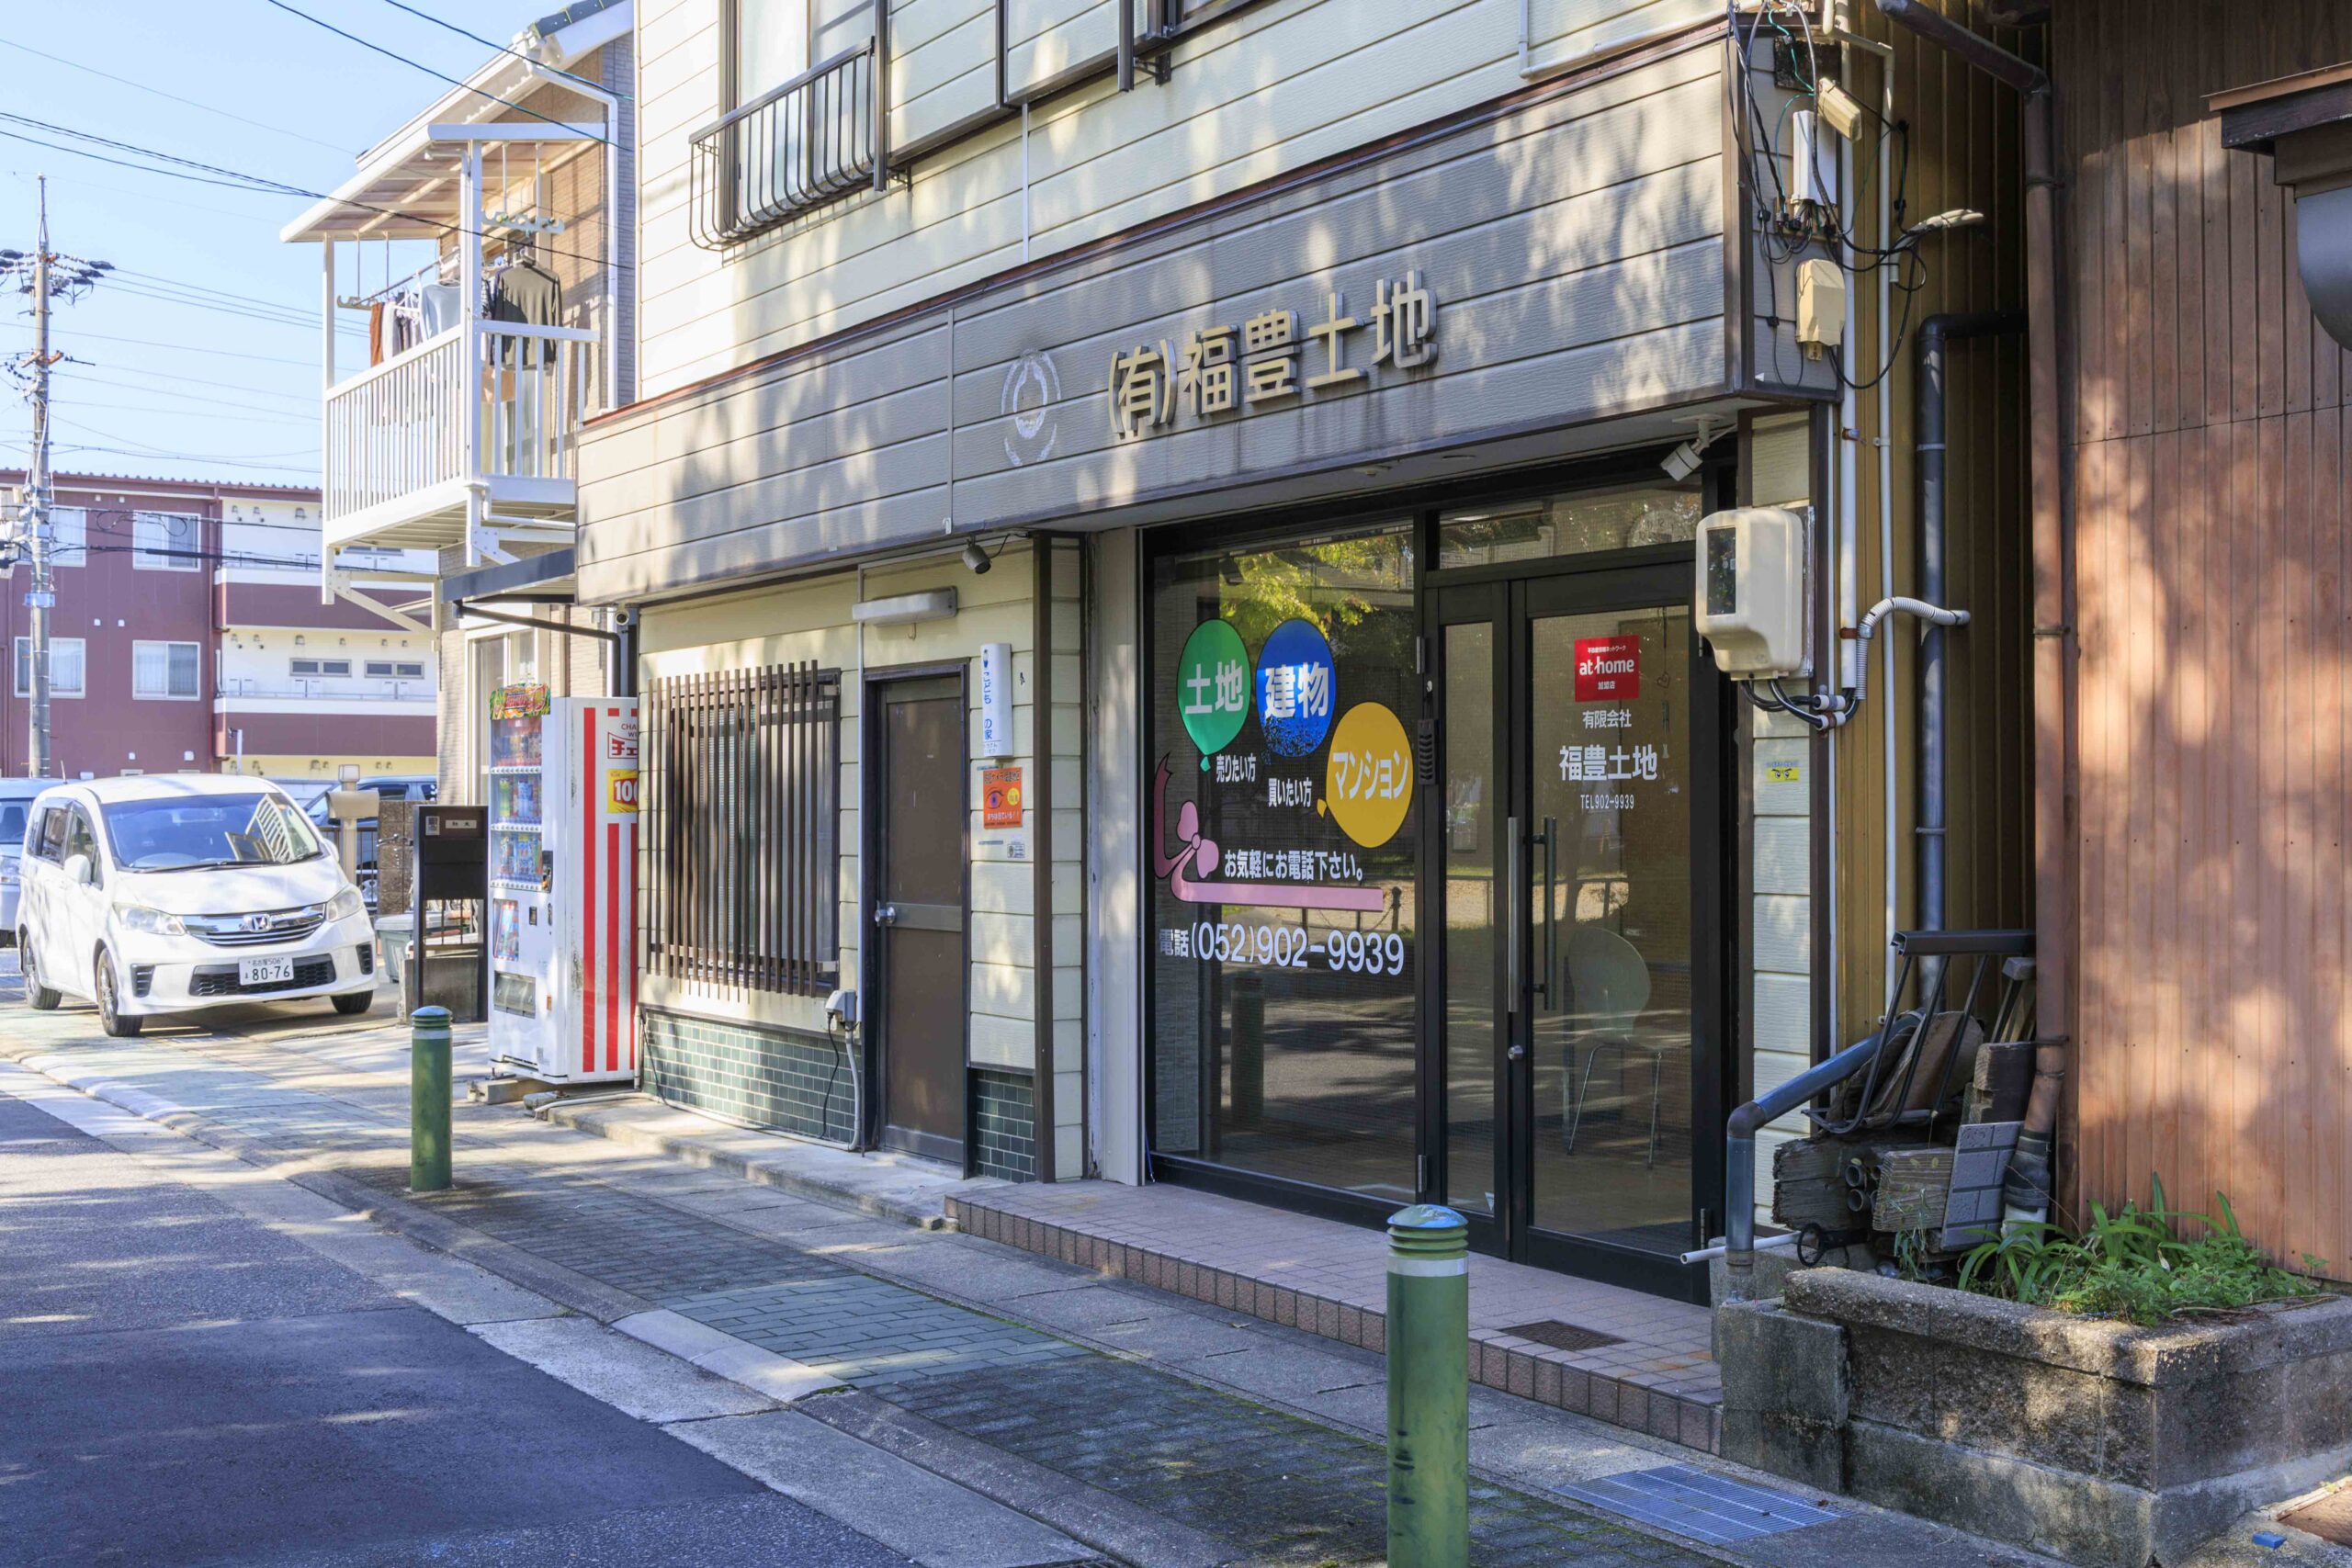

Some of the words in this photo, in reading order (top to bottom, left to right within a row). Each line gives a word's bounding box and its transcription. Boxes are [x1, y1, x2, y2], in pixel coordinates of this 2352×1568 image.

[1108, 270, 1439, 439] (有)福豊土地
[1578, 660, 1594, 675] at
[1594, 656, 1634, 674] home
[1185, 660, 1244, 715] 土地
[1265, 661, 1329, 719] 建物
[1582, 708, 1633, 729] 有限会社
[1216, 753, 1257, 783] 売りたい方
[1332, 749, 1409, 801] マンション
[1559, 743, 1658, 781] 福豊土地
[1267, 777, 1312, 807] 買いたい方
[1224, 849, 1363, 882] お気軽にお電話下さい。
[252, 965, 290, 981] 80-76
